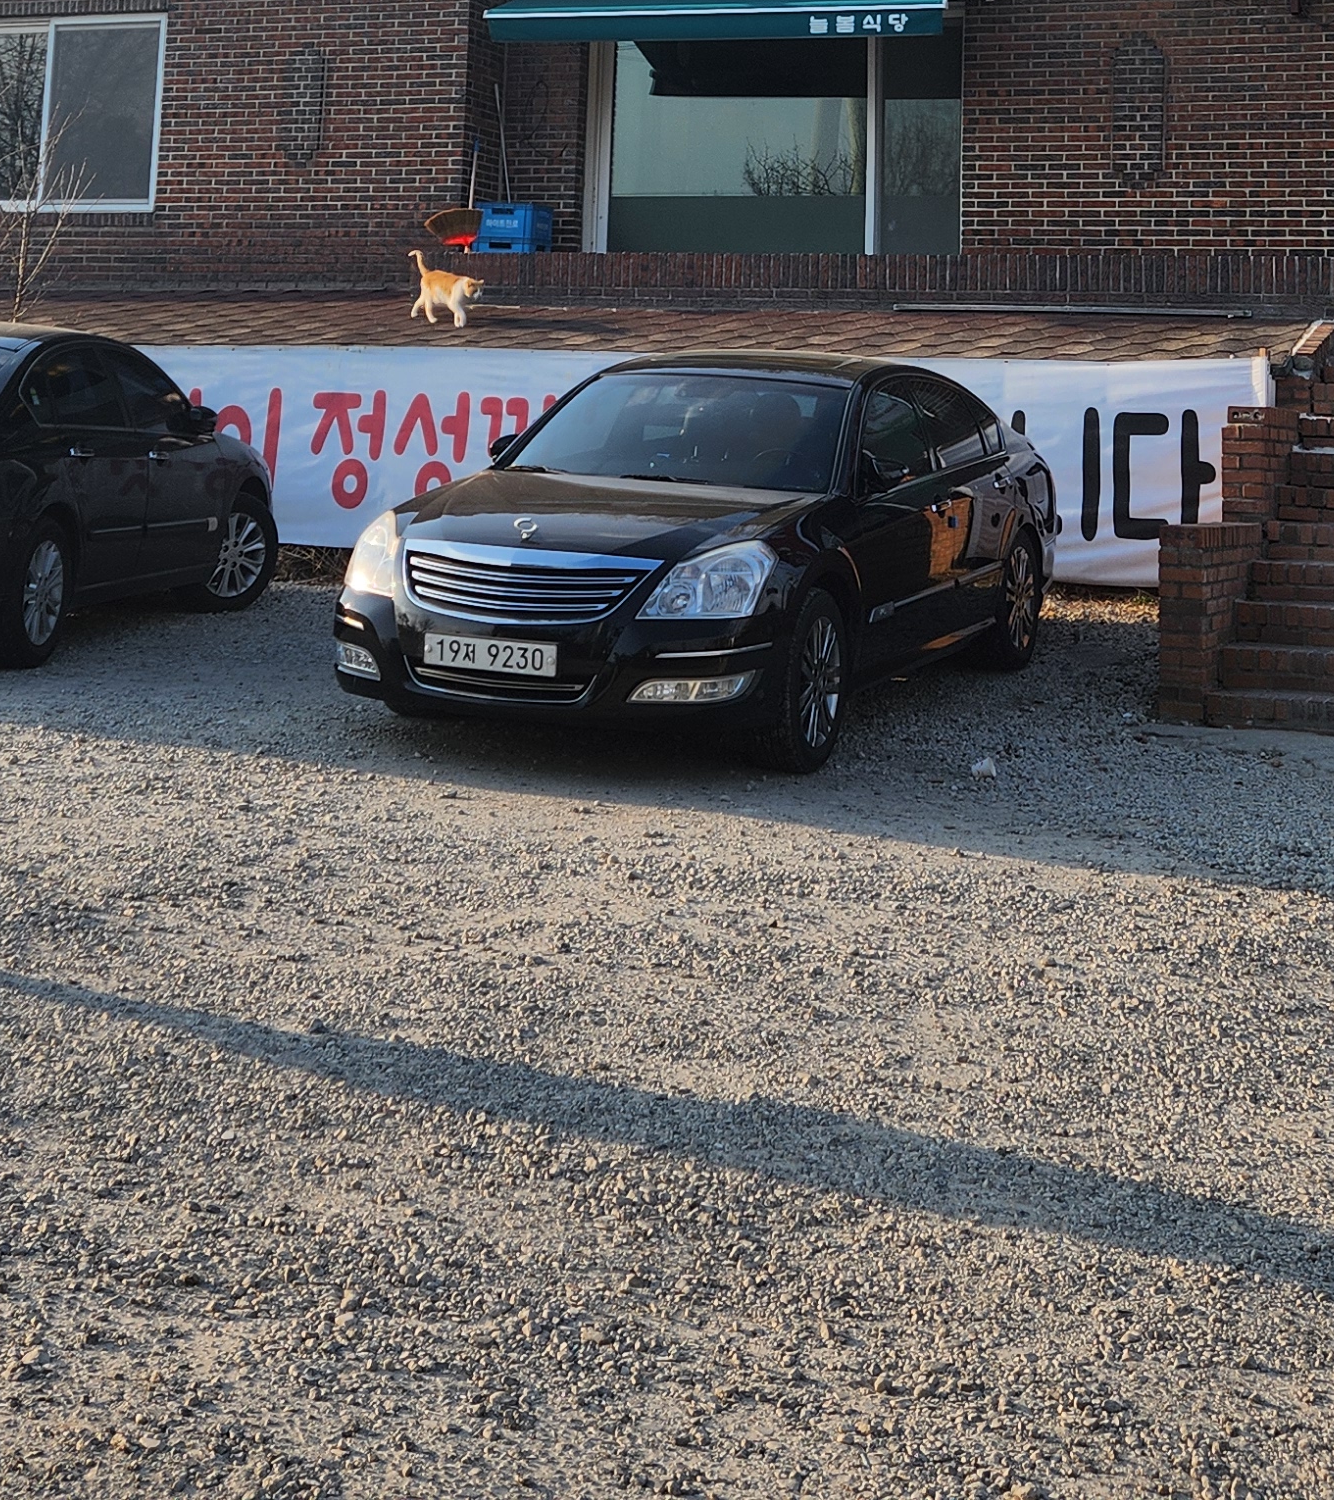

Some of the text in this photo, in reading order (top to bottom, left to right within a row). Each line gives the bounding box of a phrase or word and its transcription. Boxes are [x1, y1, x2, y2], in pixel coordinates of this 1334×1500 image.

[809, 13, 909, 34] 늘봄식당
[436, 638, 544, 671] 19저 9230
